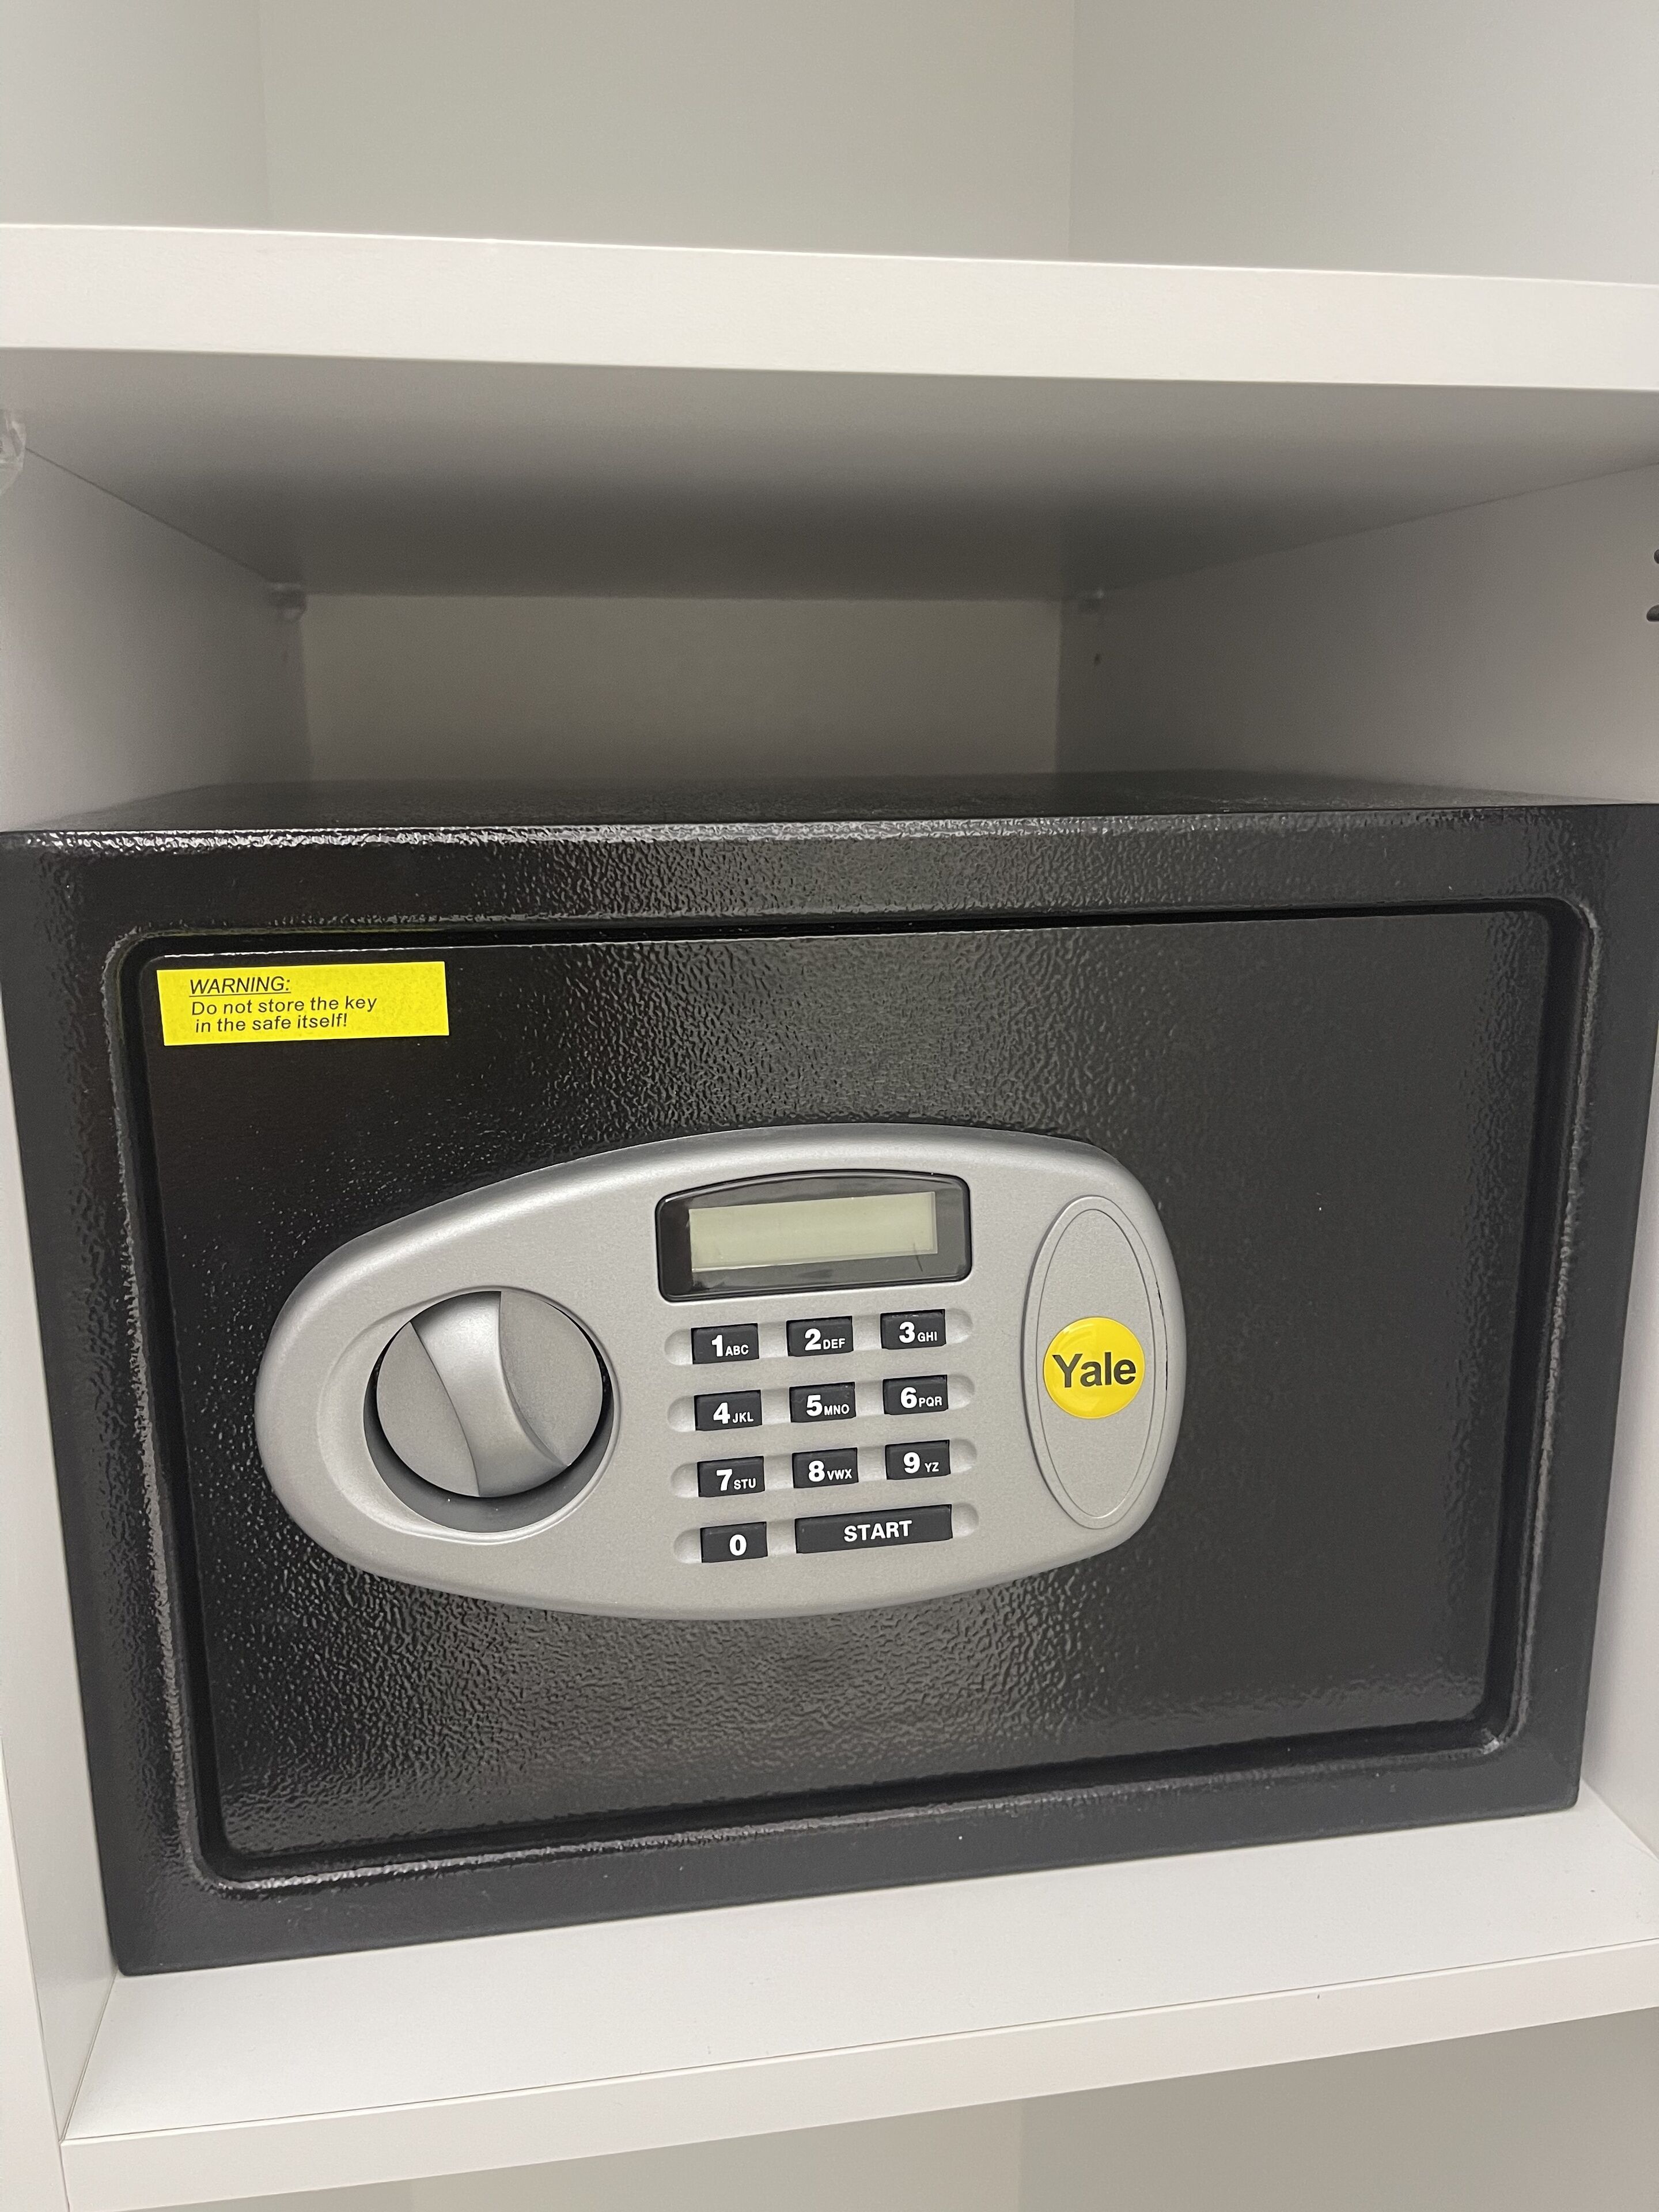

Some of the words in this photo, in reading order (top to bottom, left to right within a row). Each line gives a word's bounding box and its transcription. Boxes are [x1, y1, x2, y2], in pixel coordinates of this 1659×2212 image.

[190, 976, 291, 995] WARNING:
[192, 1001, 217, 1016] Do
[224, 999, 252, 1014] not
[258, 998, 305, 1013] store
[310, 997, 339, 1011] the
[345, 995, 377, 1012] key
[196, 1019, 211, 1033] in
[217, 1017, 246, 1032] the
[252, 1016, 291, 1031] safe
[297, 1013, 347, 1029] itself!
[1052, 1352, 1136, 1388] Yale
[844, 1520, 912, 1542] START
[729, 1534, 747, 1556] 0
